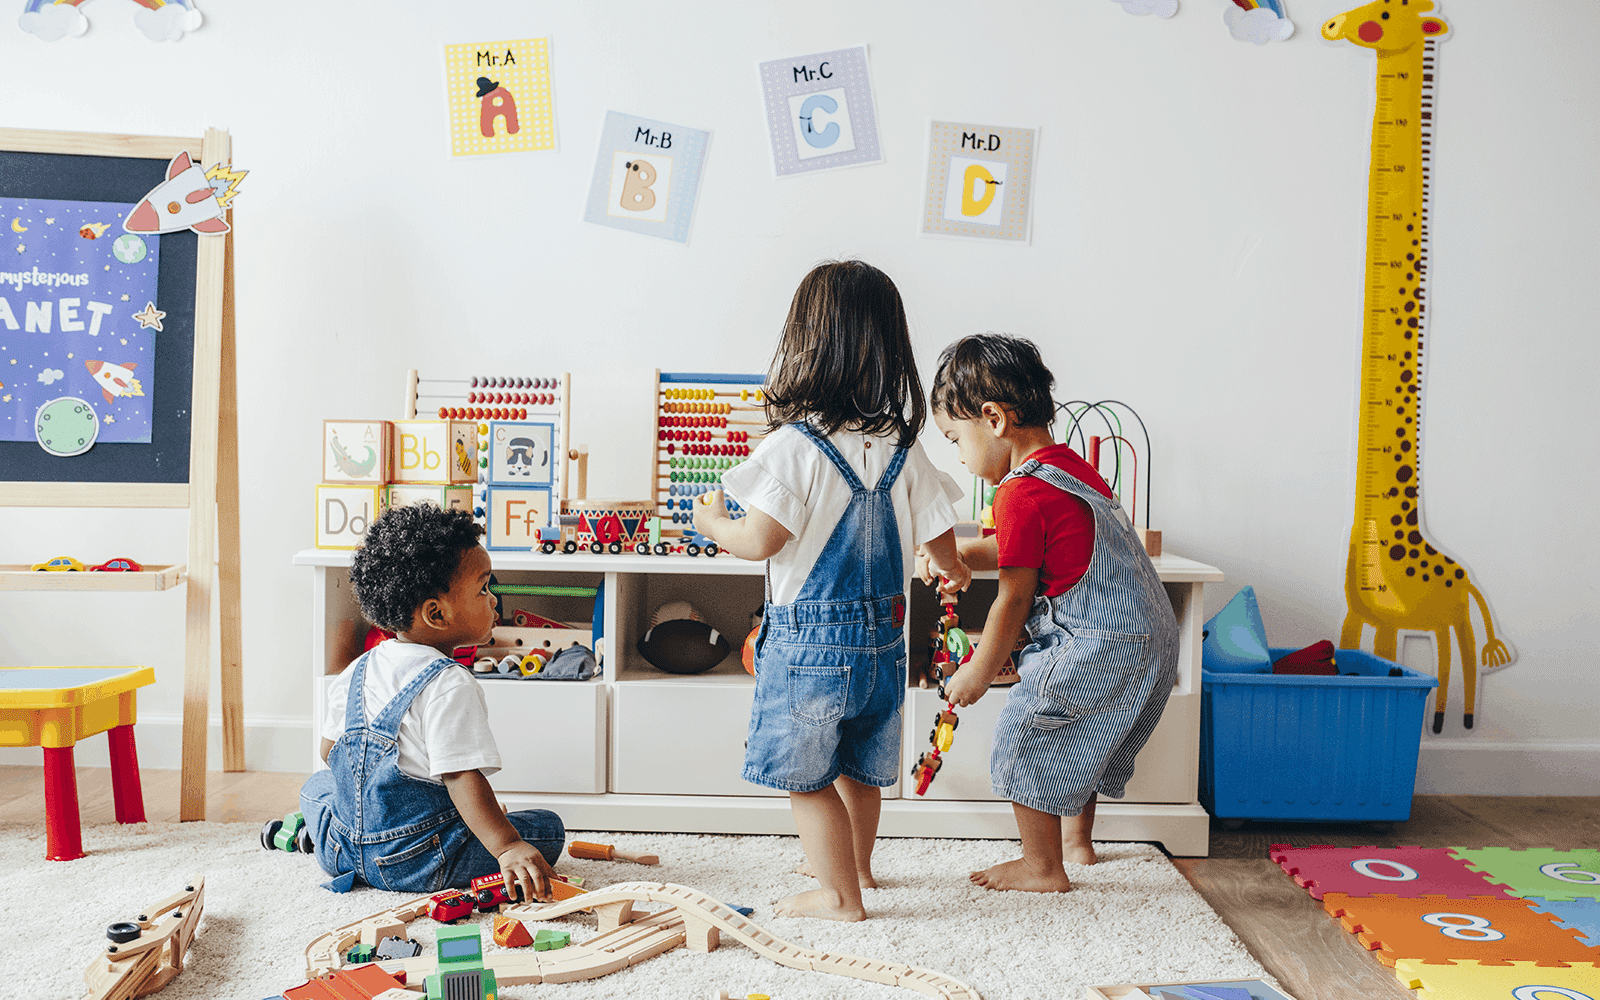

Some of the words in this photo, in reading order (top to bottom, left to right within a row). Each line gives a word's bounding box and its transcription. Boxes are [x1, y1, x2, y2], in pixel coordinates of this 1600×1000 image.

[476, 49, 516, 67] Mr.A
[793, 61, 833, 83] Mr.C
[635, 126, 672, 149] Mr.B
[961, 131, 1001, 151] Mr.D
[0, 266, 89, 292] mysterious
[496, 427, 506, 441] C
[400, 434, 441, 470] Bb
[325, 498, 368, 535] Dd
[506, 500, 538, 536] Ff
[1420, 912, 1506, 942] 8
